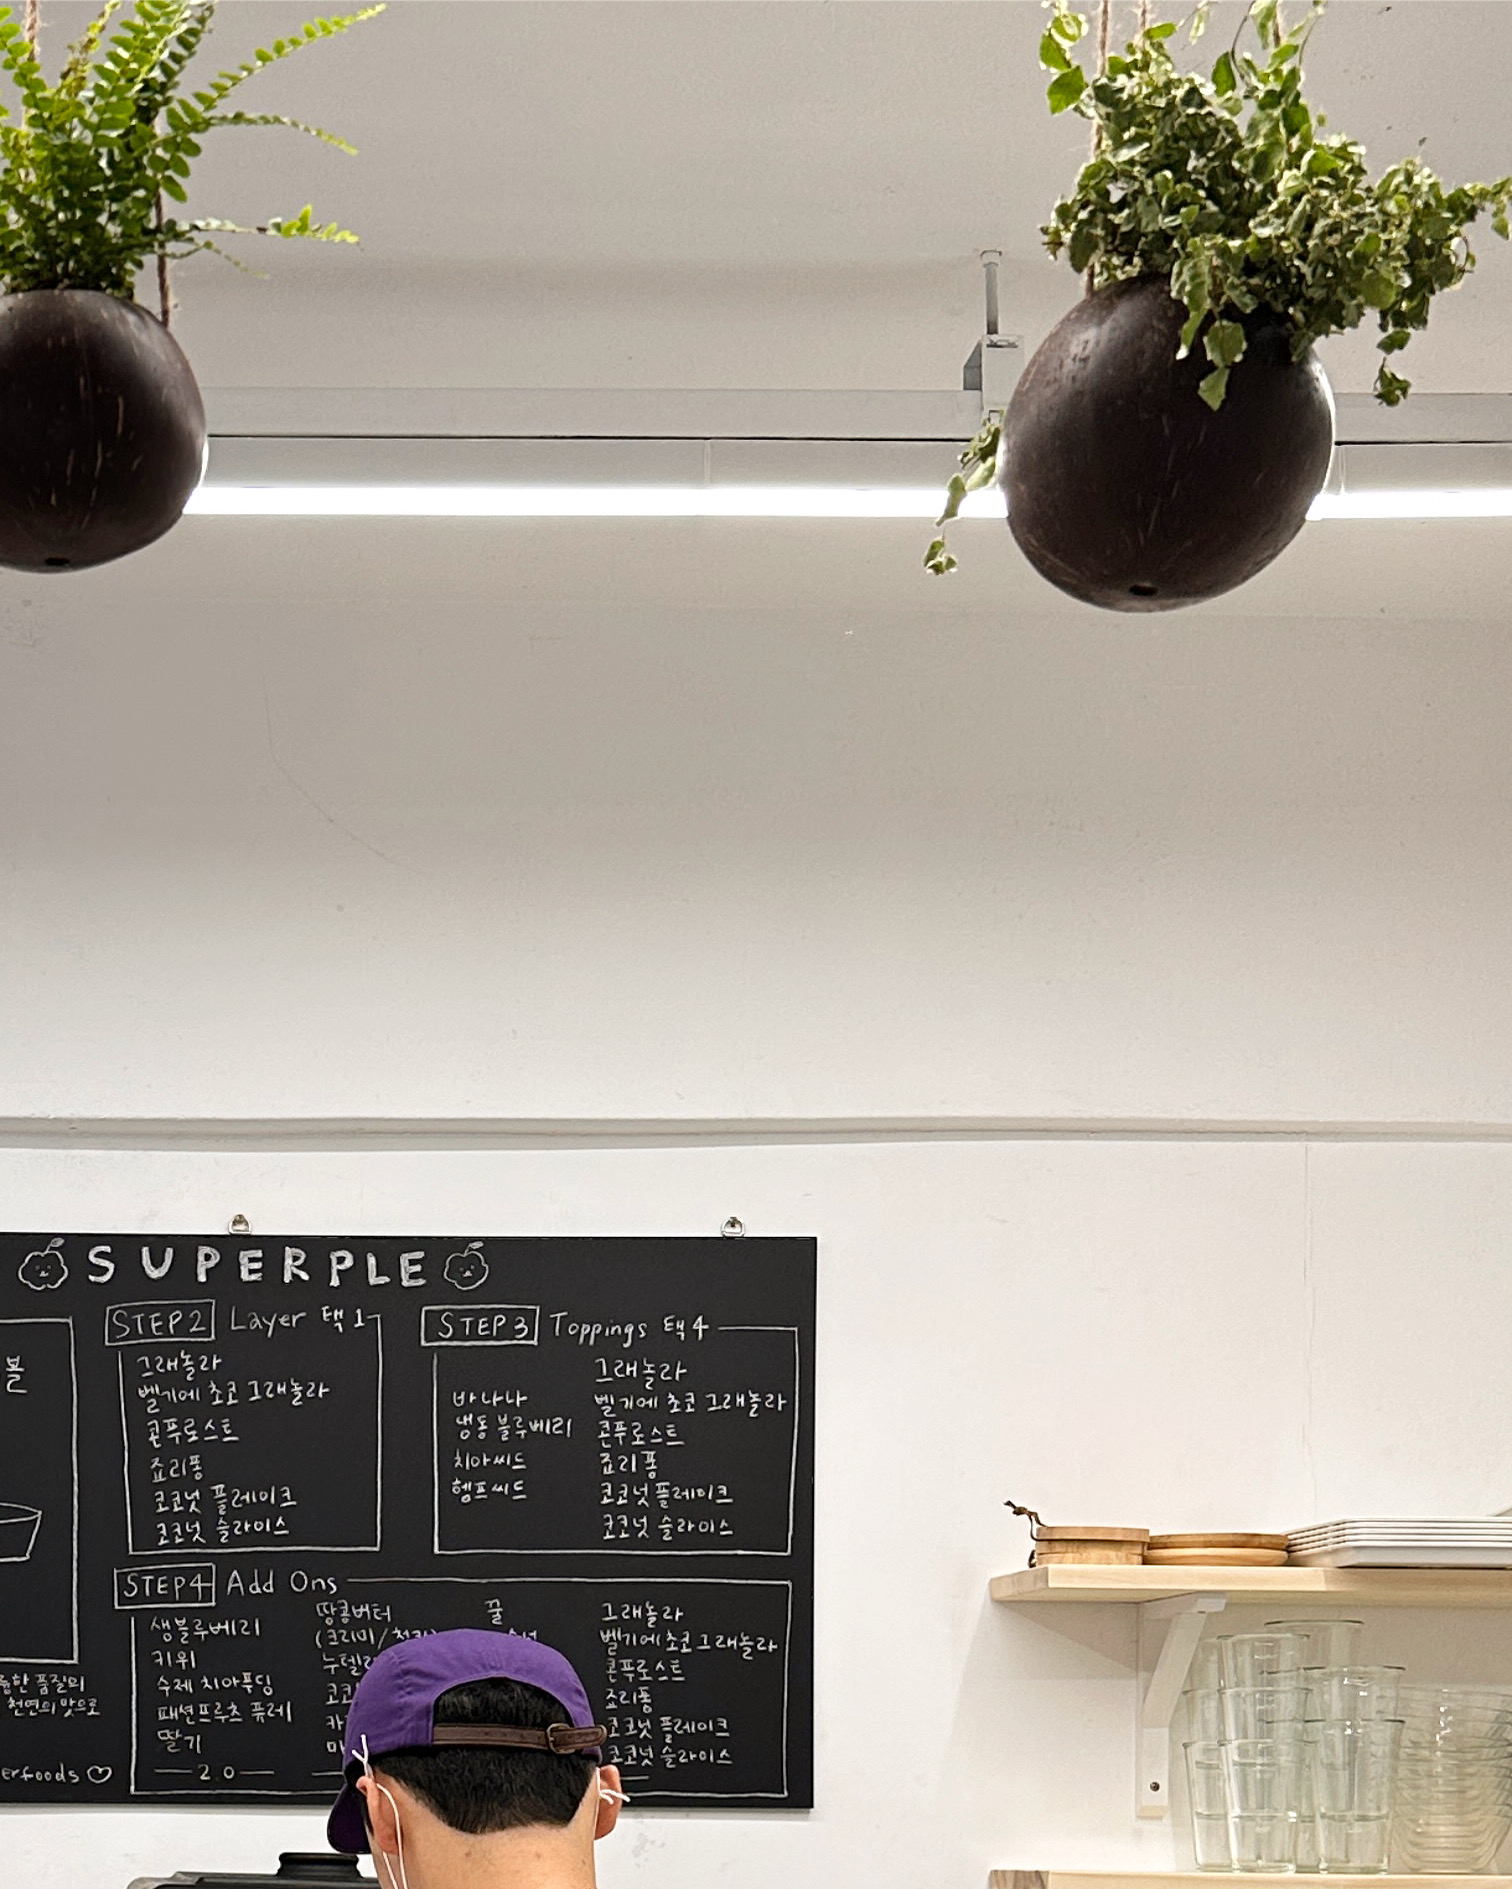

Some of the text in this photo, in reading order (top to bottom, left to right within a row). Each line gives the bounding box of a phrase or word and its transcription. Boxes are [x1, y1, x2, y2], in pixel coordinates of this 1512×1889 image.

[88, 1245, 427, 1288] SUPERPLE
[230, 1306, 307, 1338] Layer
[549, 1311, 648, 1348] Toppings
[137, 1349, 222, 1382] 그래놀라
[594, 1357, 688, 1391] 그래놀라
[138, 1378, 330, 1414] 벨기에 초코 그래놀라
[452, 1389, 528, 1408] 바나나
[594, 1389, 787, 1418] 벨기에 초코 그래놀라
[455, 1412, 572, 1442] 냉동 블루베리
[454, 1450, 527, 1471] 치아씨드
[154, 1483, 297, 1516] 코코넛 플레이크
[600, 1481, 734, 1509] 코코넛 플레이크
[156, 1515, 290, 1551] 코코넛 슬라이스
[603, 1513, 734, 1541] 코코넛 슬라이스
[227, 1569, 274, 1596] Add
[290, 1570, 337, 1595] Ons
[316, 1599, 391, 1626] 땅콩버터
[602, 1601, 684, 1628] 그래놀라
[599, 1627, 778, 1660] 벨기에 초코 그래놀라
[152, 1650, 196, 1670] 키위
[37, 1673, 84, 1695] 품질의
[158, 1672, 273, 1697] 수제 치아푸딩
[325, 1682, 360, 1706] 코코
[251, 1701, 292, 1723] 퓨레
[157, 1729, 201, 1754] 딸기
[608, 1716, 730, 1744] 코코넛 플레이크
[606, 1744, 732, 1770] 코코넛 슬라이스
